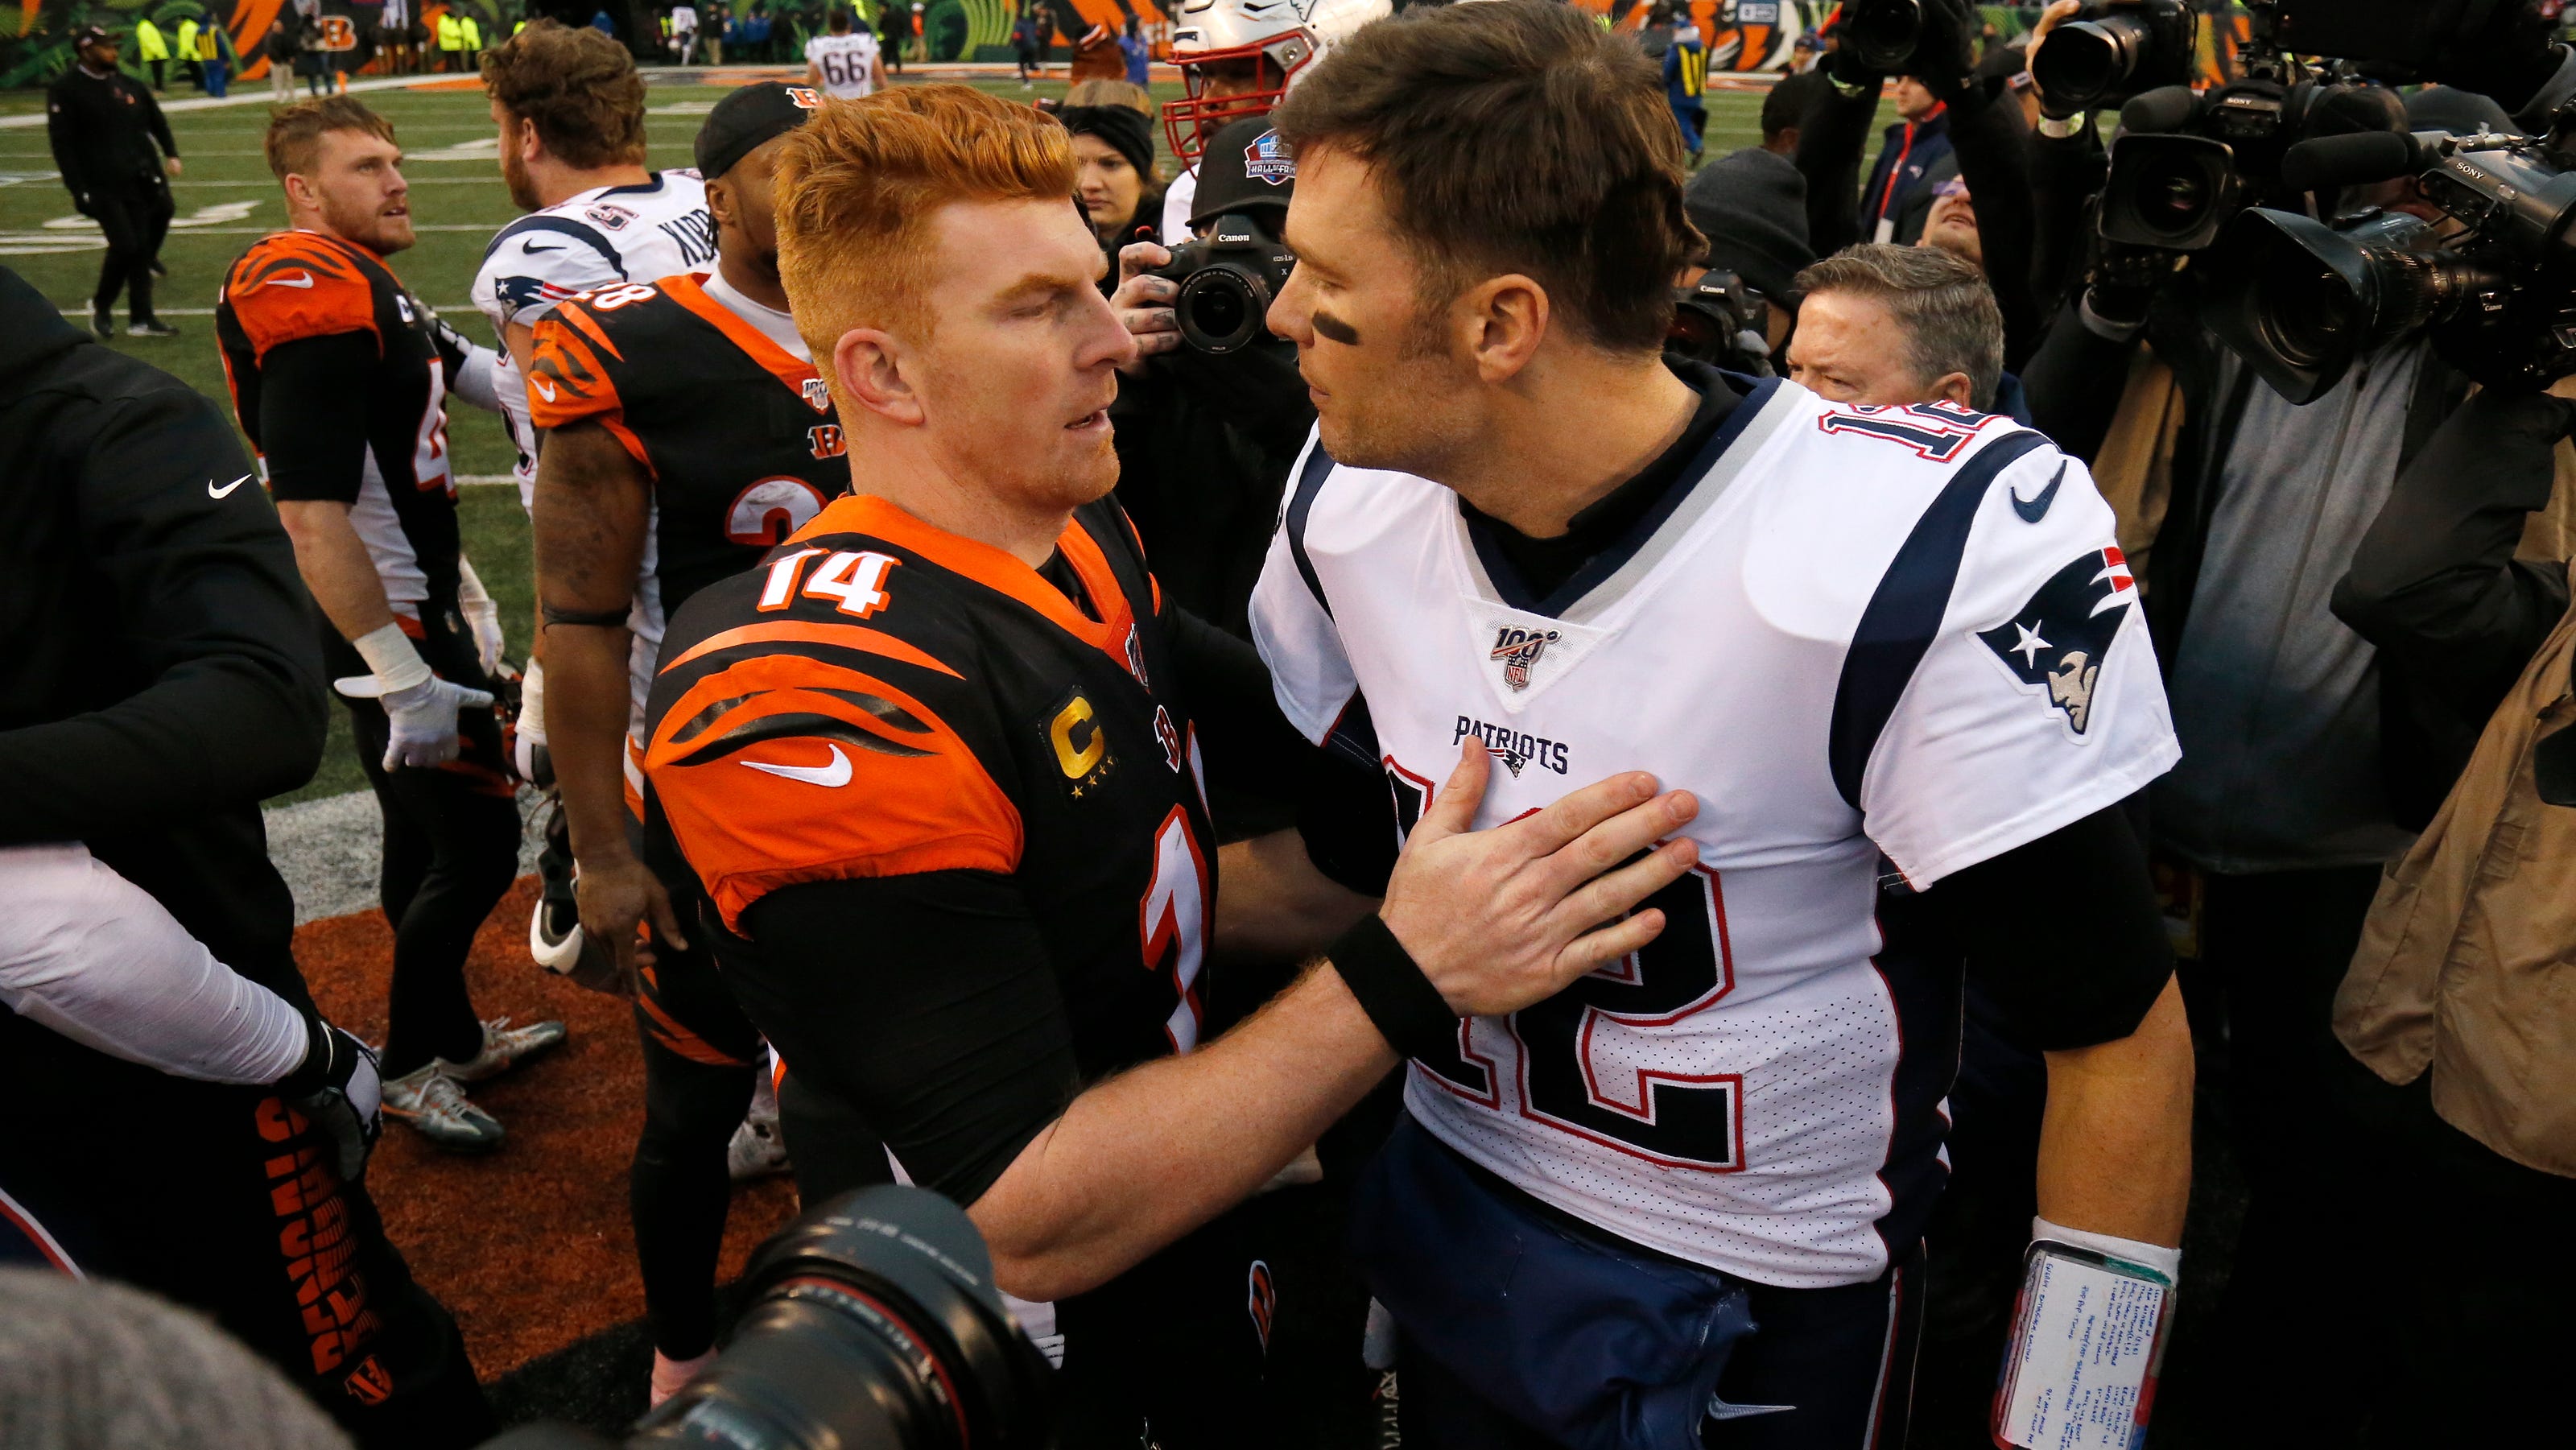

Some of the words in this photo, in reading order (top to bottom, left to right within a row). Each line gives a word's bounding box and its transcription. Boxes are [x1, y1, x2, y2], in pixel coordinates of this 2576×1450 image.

[824, 51, 865, 85] 66
[1250, 165, 1273, 173] HALL
[1278, 165, 1296, 174] FAM
[2456, 162, 2484, 180] SONY
[1218, 234, 1250, 242] Canon
[1699, 284, 1726, 294] Canon
[757, 547, 901, 620] 14
[1495, 627, 1545, 658] 100
[1507, 667, 1526, 684] NFL
[1051, 696, 1106, 779] C
[1453, 715, 1569, 775] PATRIOTS
